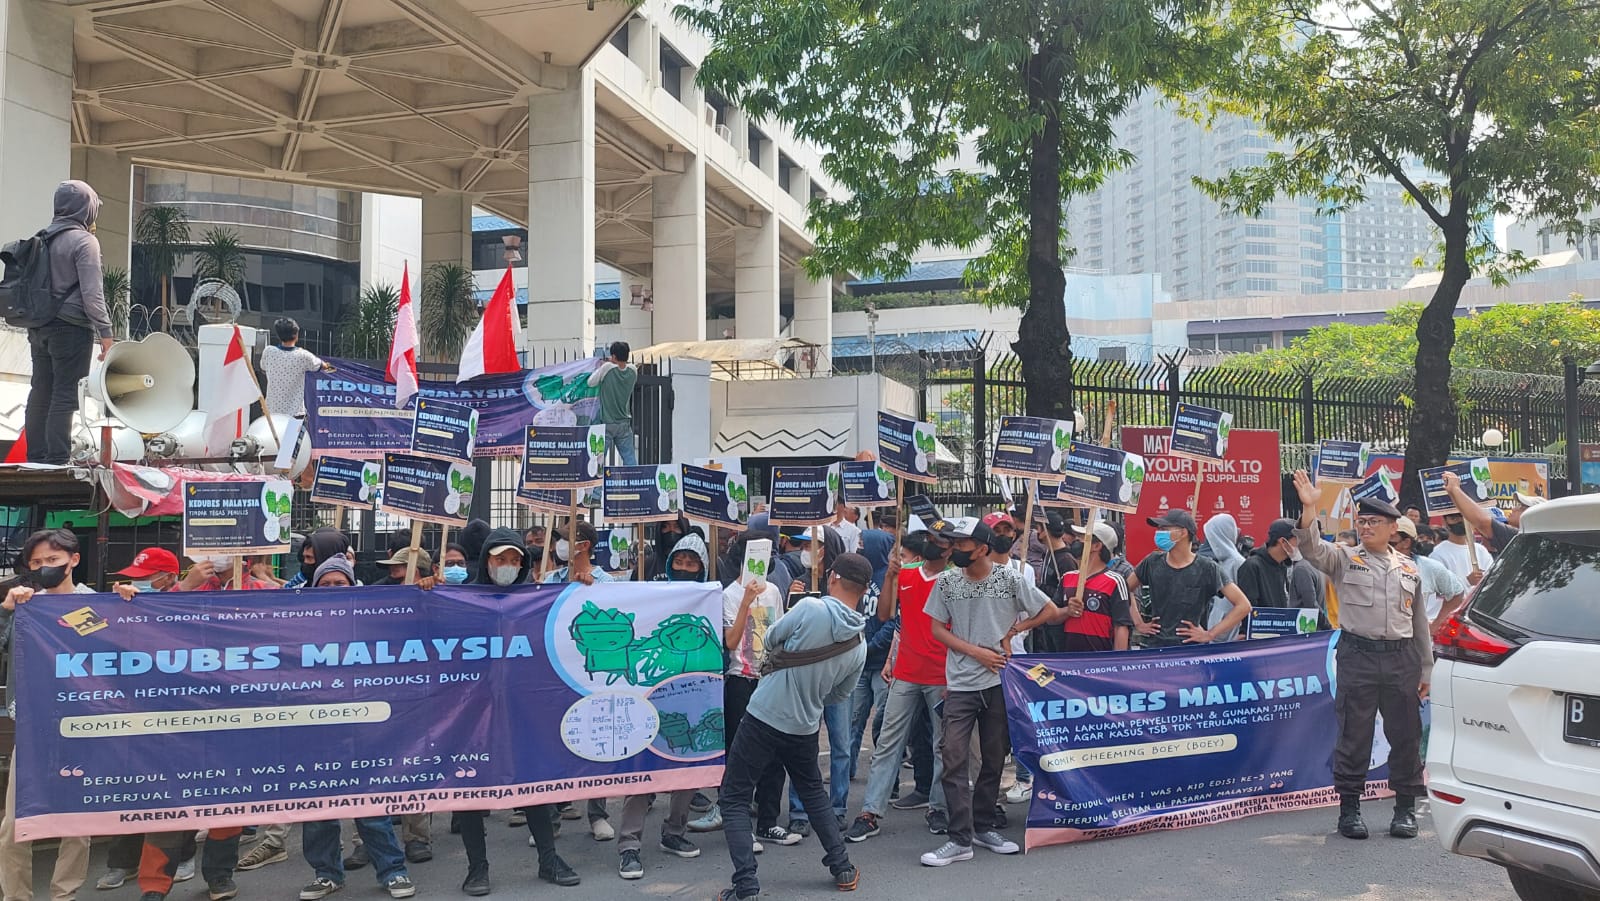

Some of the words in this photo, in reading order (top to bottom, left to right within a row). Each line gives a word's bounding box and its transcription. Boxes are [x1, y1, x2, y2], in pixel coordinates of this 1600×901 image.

[316, 379, 397, 395] KEDUBE
[316, 395, 373, 404] TINDAK
[529, 440, 556, 448] KEDUBES
[558, 441, 586, 449] MALAYSIA
[1024, 431, 1051, 440] MALAYSIA
[1143, 435, 1170, 454] MAT
[388, 465, 415, 475] KEDUBES
[416, 469, 446, 480] MALAYSIA
[1068, 455, 1092, 466] KEDUBES
[1093, 460, 1120, 471] MALAYSIA
[1145, 458, 1192, 472] YOUR
[1238, 460, 1262, 473] TO
[606, 479, 628, 487] KEDUBES
[630, 478, 655, 486] MALAYSIA
[775, 481, 799, 489] KEDUBES
[801, 480, 826, 488] MALAYSIA
[1207, 474, 1260, 484] SUPPLIERS
[189, 500, 220, 508] KEDUBES
[223, 499, 260, 507] MALAYSIA
[117, 615, 149, 624] AKSI
[156, 613, 210, 622] CORONG
[217, 610, 266, 621] RAKYAT
[272, 608, 323, 619] KEPUNG
[330, 608, 347, 616] KD
[353, 606, 414, 616] MALAYSIA
[55, 645, 281, 678] KEDUBES
[301, 635, 533, 668] MALAYSIA
[1061, 669, 1081, 677] AKSI
[1085, 666, 1118, 675] CORONG
[1121, 663, 1151, 672] RAKYAT
[1155, 660, 1186, 668] KEPUNG
[1204, 656, 1242, 664] MALAYSIA
[57, 689, 125, 702] SEGERA
[134, 684, 222, 699] HENTIKAN
[230, 680, 322, 694] PENJUALAN
[331, 678, 345, 689] &
[353, 674, 430, 688] PRODUKSI
[439, 672, 480, 684] BUKU
[1027, 691, 1166, 723] KEDUBES
[1179, 675, 1323, 708] MALAYSIA
[70, 719, 132, 732] KOMIK
[143, 713, 242, 729] CHEEMING
[252, 710, 299, 723] BOEY
[309, 705, 371, 721] (BOEY)
[1036, 726, 1069, 738] SEGERA
[1075, 722, 1125, 733] LAKUKAN
[1130, 712, 1203, 729] PENYELIDIKAN
[1209, 711, 1217, 719] &
[1223, 706, 1269, 718] GUNAKAN
[1273, 702, 1301, 713] JALUR
[1571, 699, 1584, 723] B
[1037, 736, 1068, 747] HUKUM
[1074, 732, 1103, 742] AGAR
[1109, 728, 1143, 738] KASUS
[1149, 726, 1168, 734] TSB
[1172, 723, 1192, 731] TDK
[1198, 717, 1247, 729] TERULANG
[1252, 715, 1274, 723] LAGI
[1280, 712, 1292, 720] !!!
[1463, 717, 1510, 733] LIVINA
[1047, 756, 1076, 768] KOMIK
[1082, 749, 1145, 761] CHEEMING
[1152, 745, 1180, 755] BOEY
[1187, 738, 1225, 751] (BOEY)
[82, 773, 168, 787] BERJUDUL
[177, 768, 226, 781] WHEN
[236, 768, 242, 777] I
[251, 764, 286, 775] WAS
[295, 764, 305, 773] A
[314, 761, 342, 772] KID
[351, 758, 393, 769] EDISI
[403, 754, 443, 766] KE-3
[450, 752, 490, 763] YANG
[83, 791, 172, 804] DIPERJUAL
[182, 786, 252, 799] BELIKAN
[263, 783, 279, 793] DI
[289, 777, 360, 791] PASARAN
[369, 772, 445, 785] MALAYSIA
[120, 811, 188, 823] KARENA
[194, 805, 246, 818] TELAH
[250, 799, 324, 815] MELUKAI
[330, 795, 366, 809] HATI
[369, 793, 403, 806] WNI
[408, 791, 448, 804] ATAU
[453, 786, 514, 800] PEKERJA
[517, 781, 575, 796] MIGRAN
[578, 773, 652, 790] INDONESIA
[1055, 800, 1103, 811] BERJUDUL
[1106, 792, 1135, 804] WHEN
[1150, 788, 1172, 797] WAS
[1187, 782, 1204, 791] KID
[1209, 778, 1235, 787] EDISI
[1241, 774, 1265, 783] KE-3
[1270, 769, 1294, 778] YANG
[385, 802, 426, 814] (PMI)
[1054, 813, 1109, 825] DIPERJUAL
[1112, 804, 1150, 818] BELIKAN
[1171, 793, 1212, 807] PASARAN
[1217, 785, 1263, 797] MALAYSIA
[1140, 821, 1174, 834] RUSAK
[1177, 812, 1229, 829] HUBUNGAN
[1231, 804, 1273, 817] BILATERAL
[1277, 797, 1323, 808] INDONESIA
[1165, 811, 1188, 823] HATI
[1190, 809, 1209, 818] WNI
[1210, 804, 1233, 814] ATAU
[1235, 797, 1268, 809] PEKERJA
[1270, 793, 1309, 803] MIGRAN
